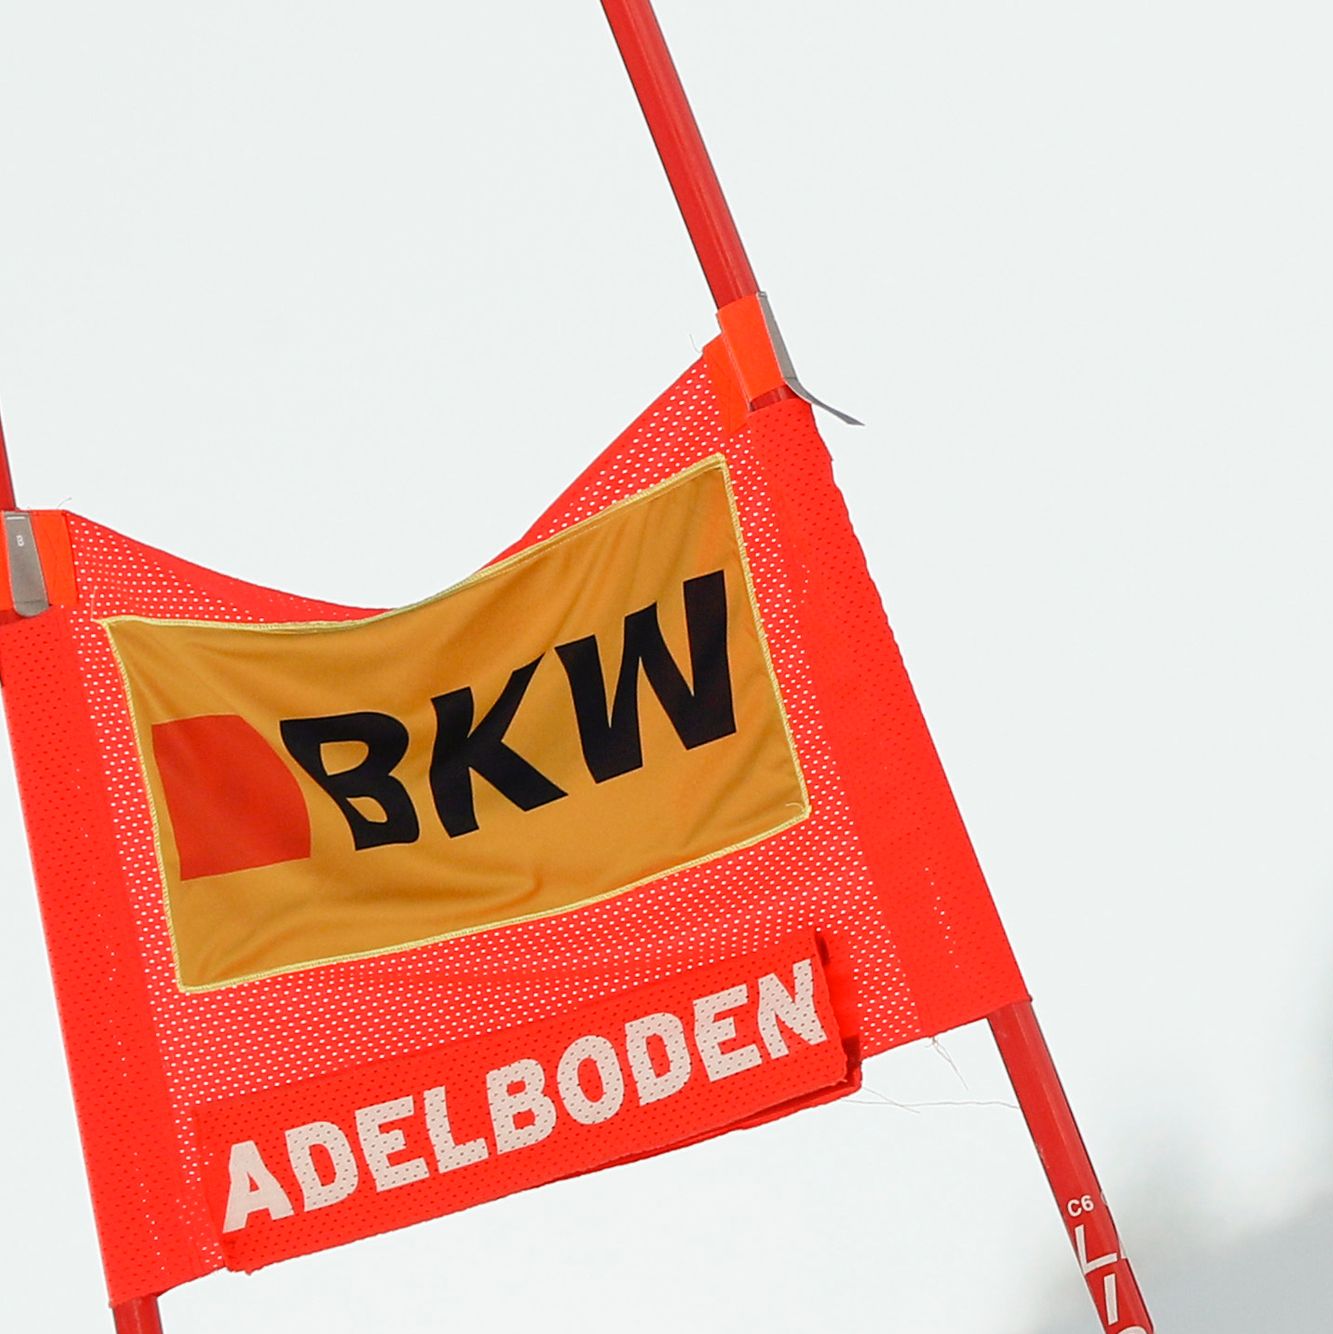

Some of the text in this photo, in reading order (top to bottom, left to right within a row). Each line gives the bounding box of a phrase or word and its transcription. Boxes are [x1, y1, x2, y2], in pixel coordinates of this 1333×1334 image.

[280, 569, 737, 850] BKW
[222, 959, 828, 1234] ADELBODEN
[1067, 1195, 1094, 1217] C6
